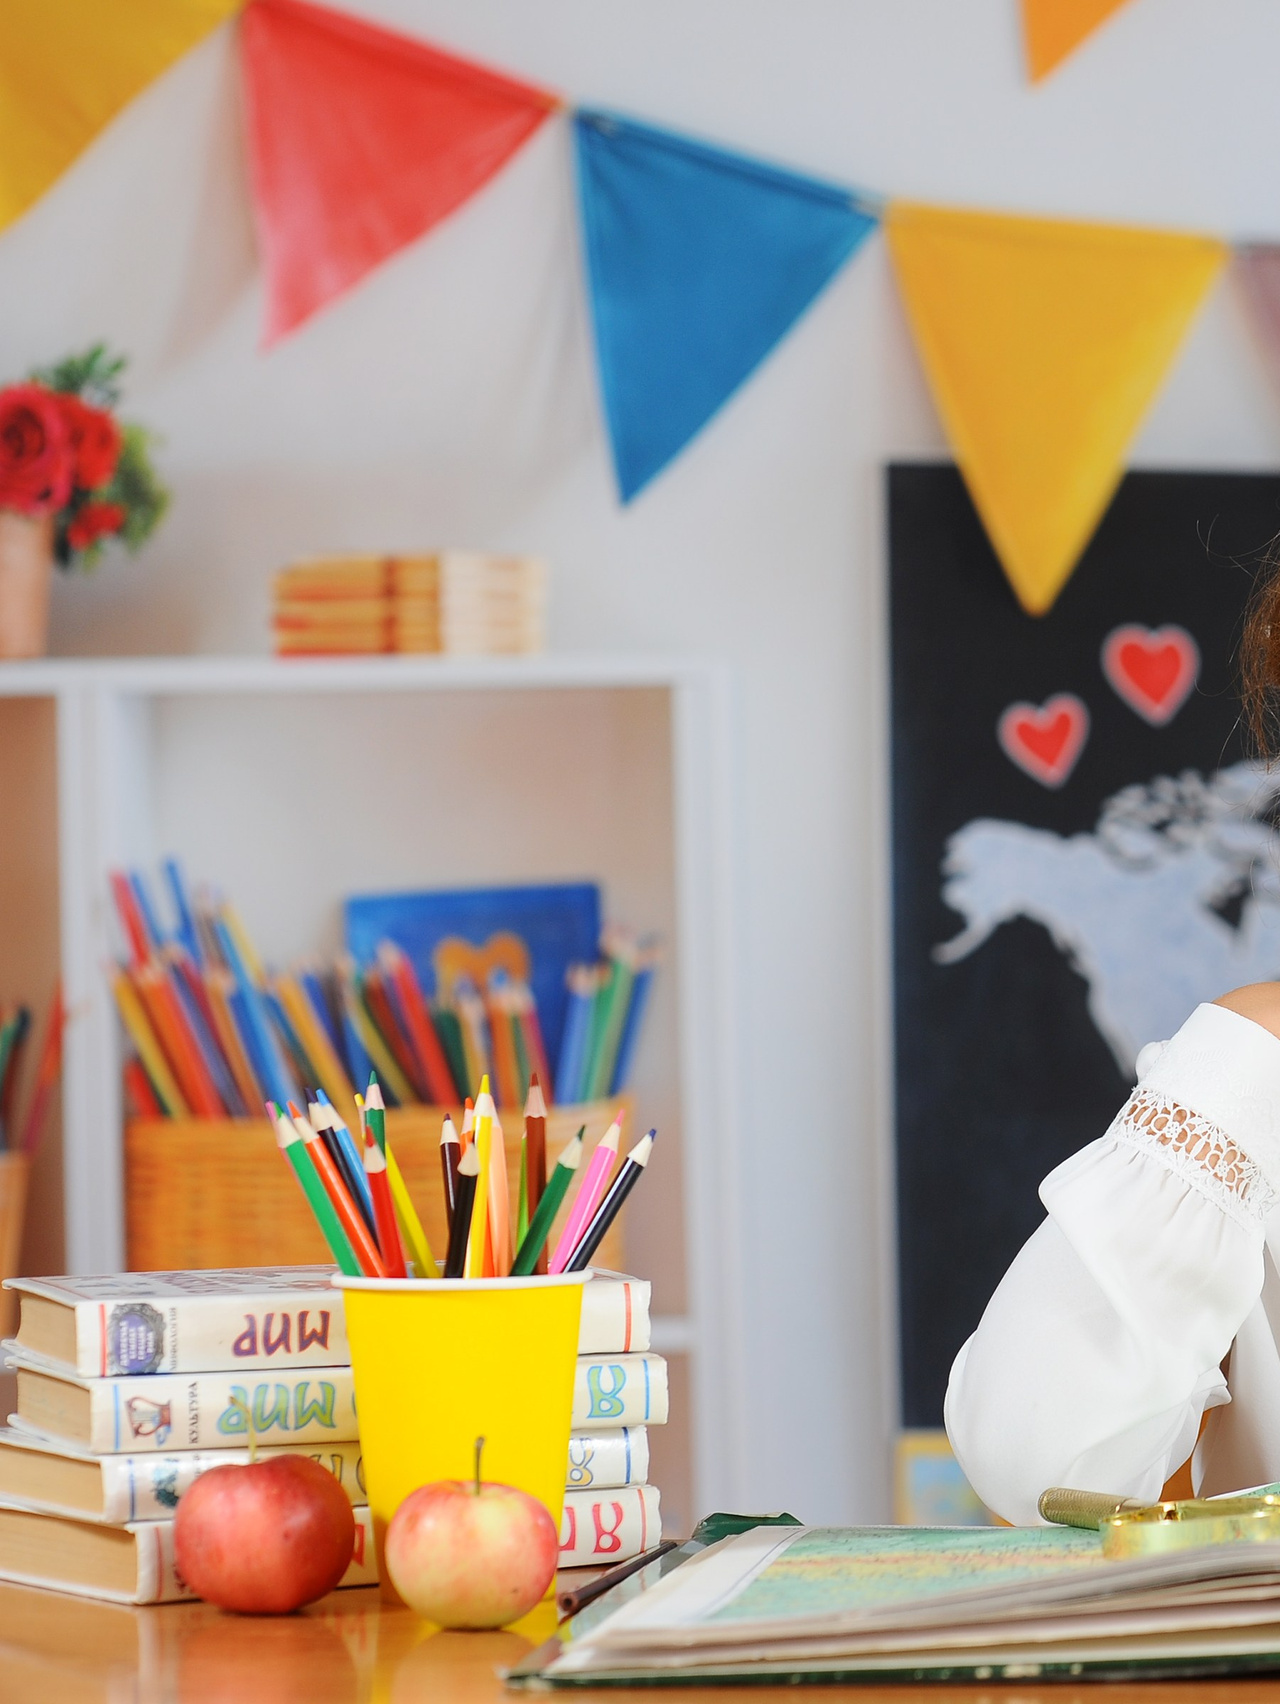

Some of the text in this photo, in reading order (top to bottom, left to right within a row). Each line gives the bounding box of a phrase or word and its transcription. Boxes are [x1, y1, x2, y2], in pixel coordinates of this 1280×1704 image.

[232, 1310, 331, 1358] МИР
[187, 1382, 199, 1445] КУЛЬТУРА
[216, 1365, 627, 1436] Я МИР
[592, 1501, 624, 1553] Я
